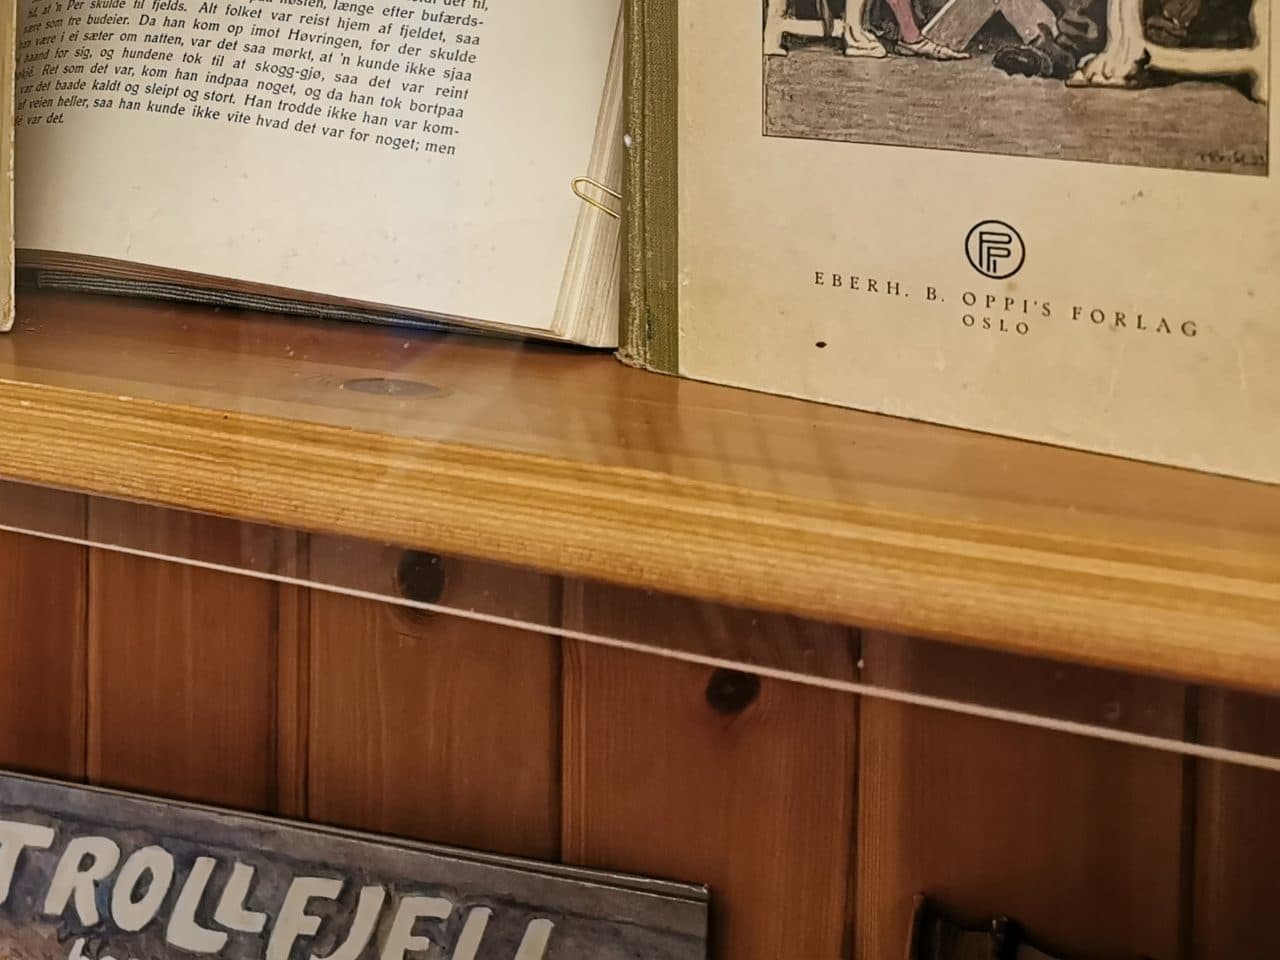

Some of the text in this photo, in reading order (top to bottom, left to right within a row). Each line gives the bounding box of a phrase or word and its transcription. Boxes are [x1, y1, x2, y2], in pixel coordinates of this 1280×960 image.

[28, 96, 54, 109] veien
[57, 95, 89, 109] heller,
[93, 98, 113, 108] saa
[118, 98, 141, 111] han
[147, 100, 185, 116] kunde
[192, 105, 220, 120] ikke
[227, 111, 251, 125] vite
[256, 114, 290, 130] hvad
[294, 119, 317, 133] det
[322, 126, 344, 138] var
[349, 128, 370, 142] for
[375, 133, 420, 152] noget;
[424, 141, 456, 156] men
[814, 271, 909, 297] EBERH.
[926, 287, 945, 303] B.
[1072, 306, 1198, 338] FORLAG
[962, 313, 1029, 336] OSLO
